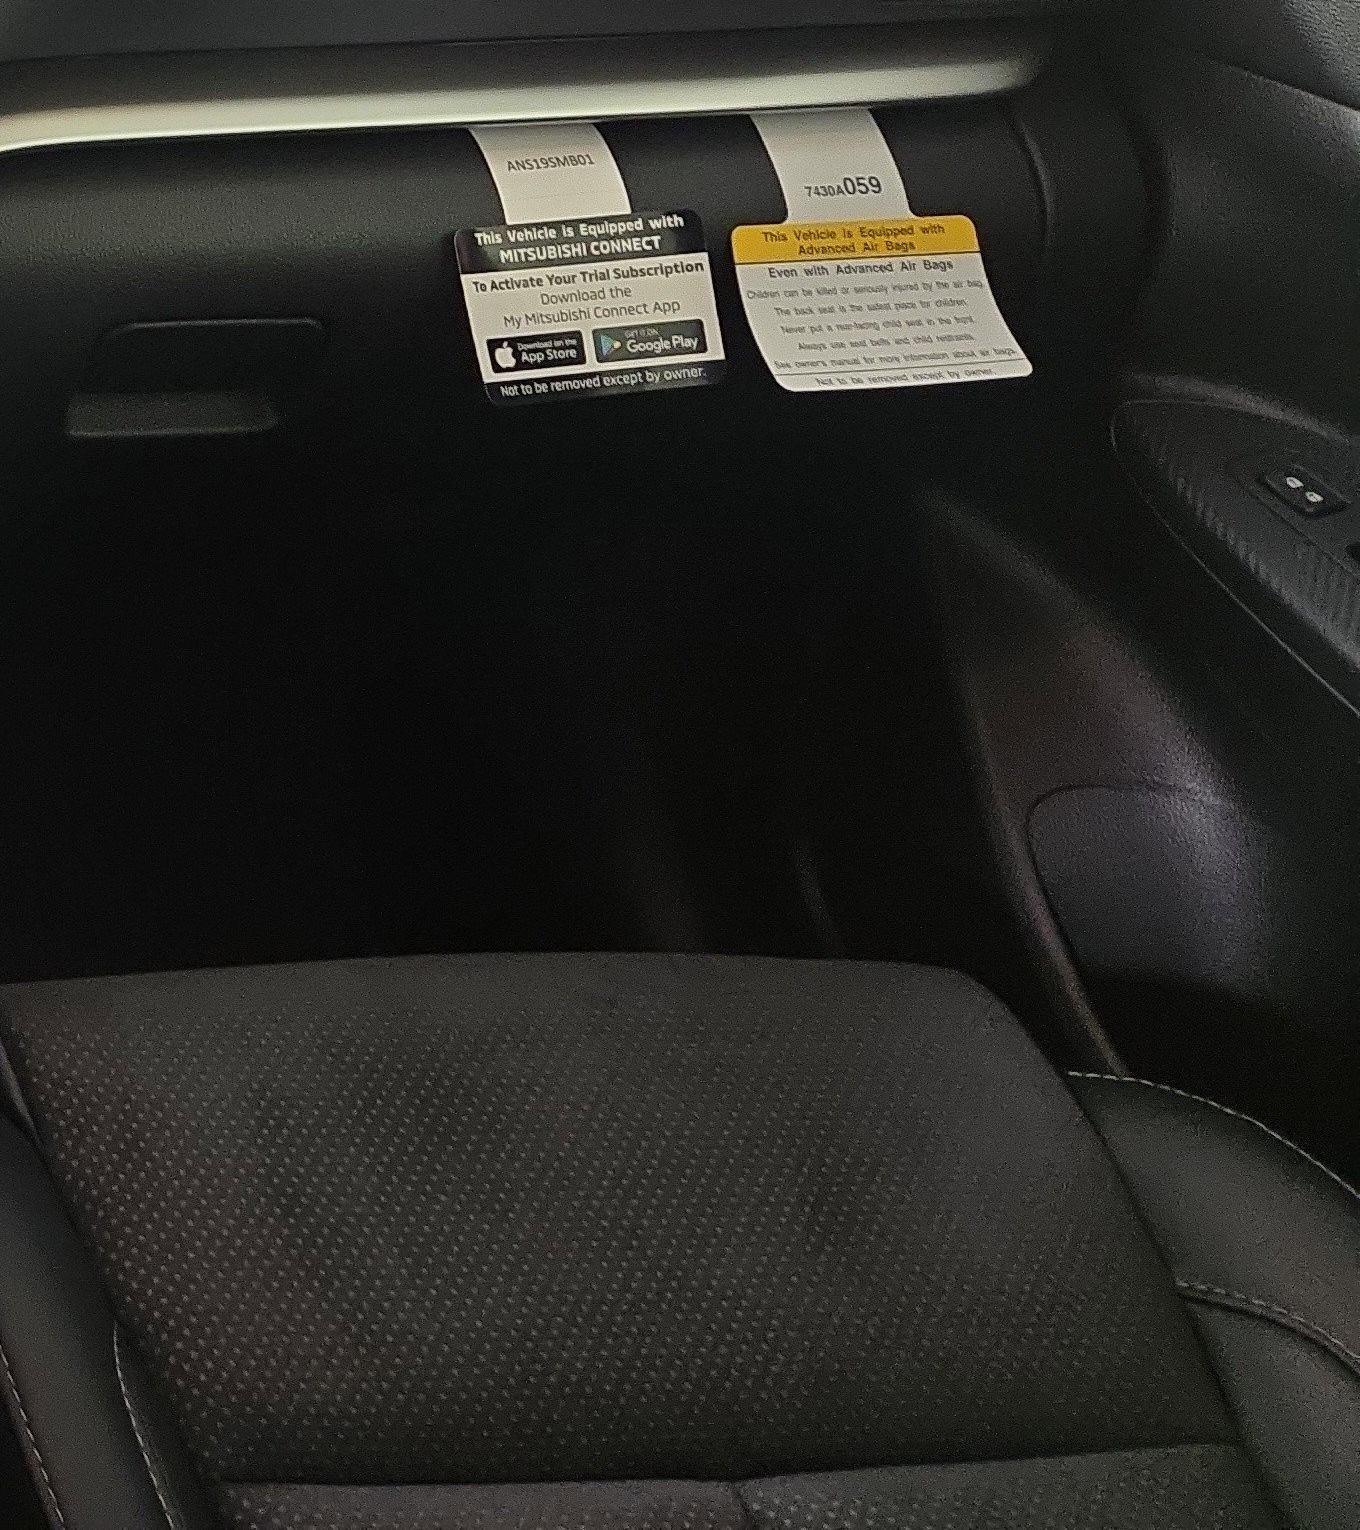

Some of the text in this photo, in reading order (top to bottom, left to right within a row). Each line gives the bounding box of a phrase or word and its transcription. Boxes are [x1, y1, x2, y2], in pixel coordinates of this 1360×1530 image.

[474, 213, 684, 246] This Vehicle is Equipped with
[762, 224, 946, 243] This Vehicle is Equipped with
[499, 235, 661, 264] MITSUBISHI CONNECT
[798, 240, 915, 255] Advanced Air Bags
[473, 260, 705, 293] To Activate Your Trial Subscription
[768, 259, 954, 279] Even with Advanced Air Bags
[540, 285, 632, 306] Download the
[503, 299, 681, 330] My Mitsubishi Connect App
[627, 334, 699, 354] Google Play
[521, 348, 577, 364] App Store
[500, 384, 519, 398] Not
[521, 383, 532, 395] to
[534, 381, 548, 394] be
[550, 376, 600, 392] removed
[602, 372, 643, 388] except
[645, 370, 660, 384] by
